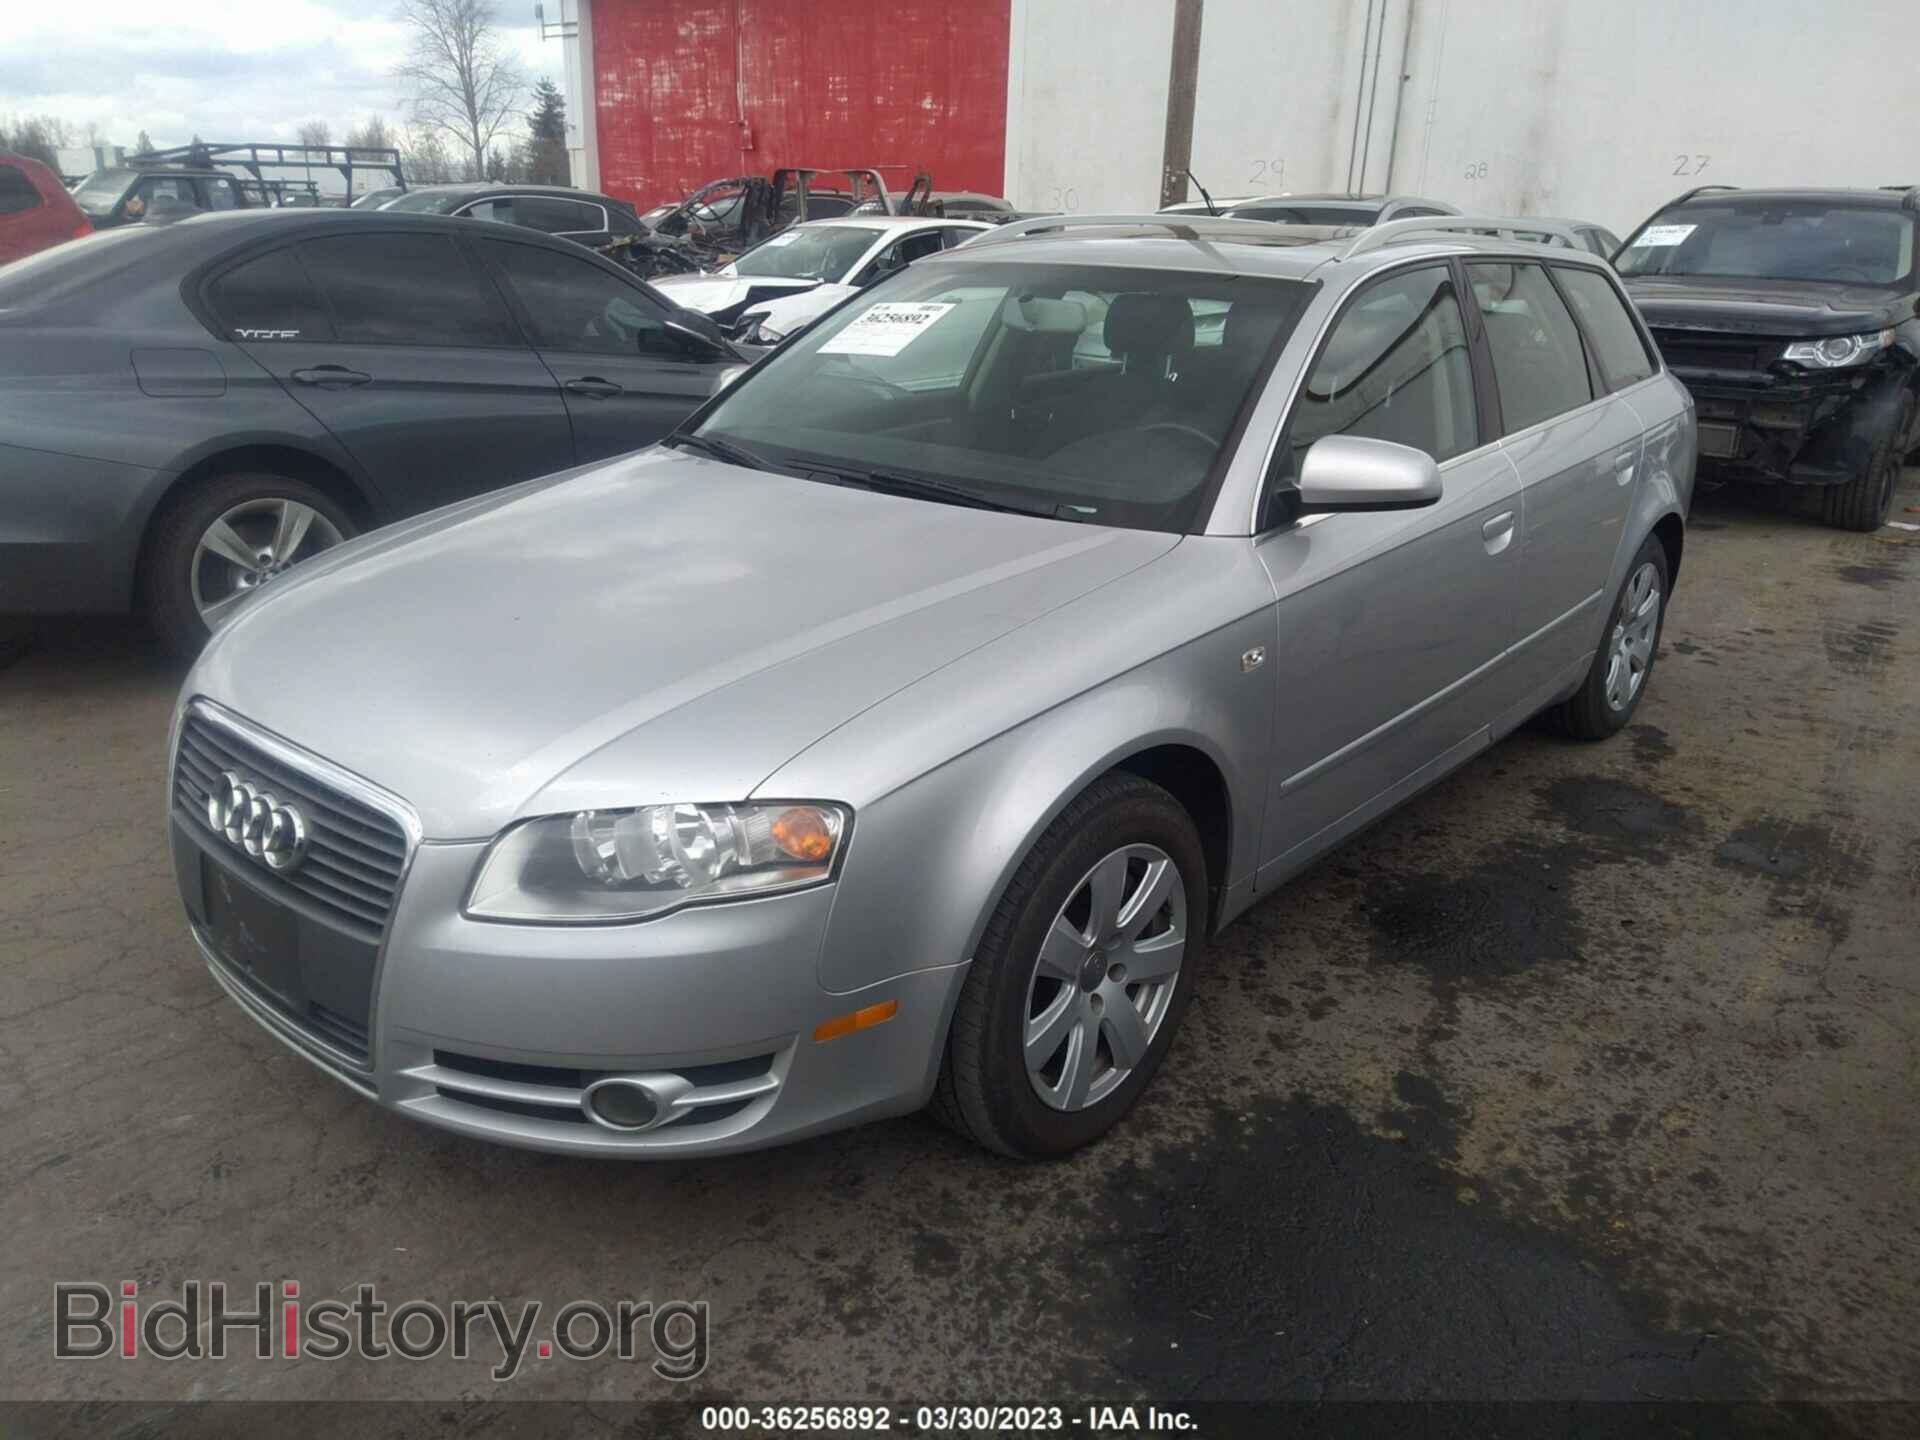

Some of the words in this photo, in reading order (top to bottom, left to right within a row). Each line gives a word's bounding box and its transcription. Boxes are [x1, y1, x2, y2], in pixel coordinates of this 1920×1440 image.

[1248, 158, 1287, 187] 29
[1464, 161, 1489, 180] 28
[1671, 154, 1712, 176] 27
